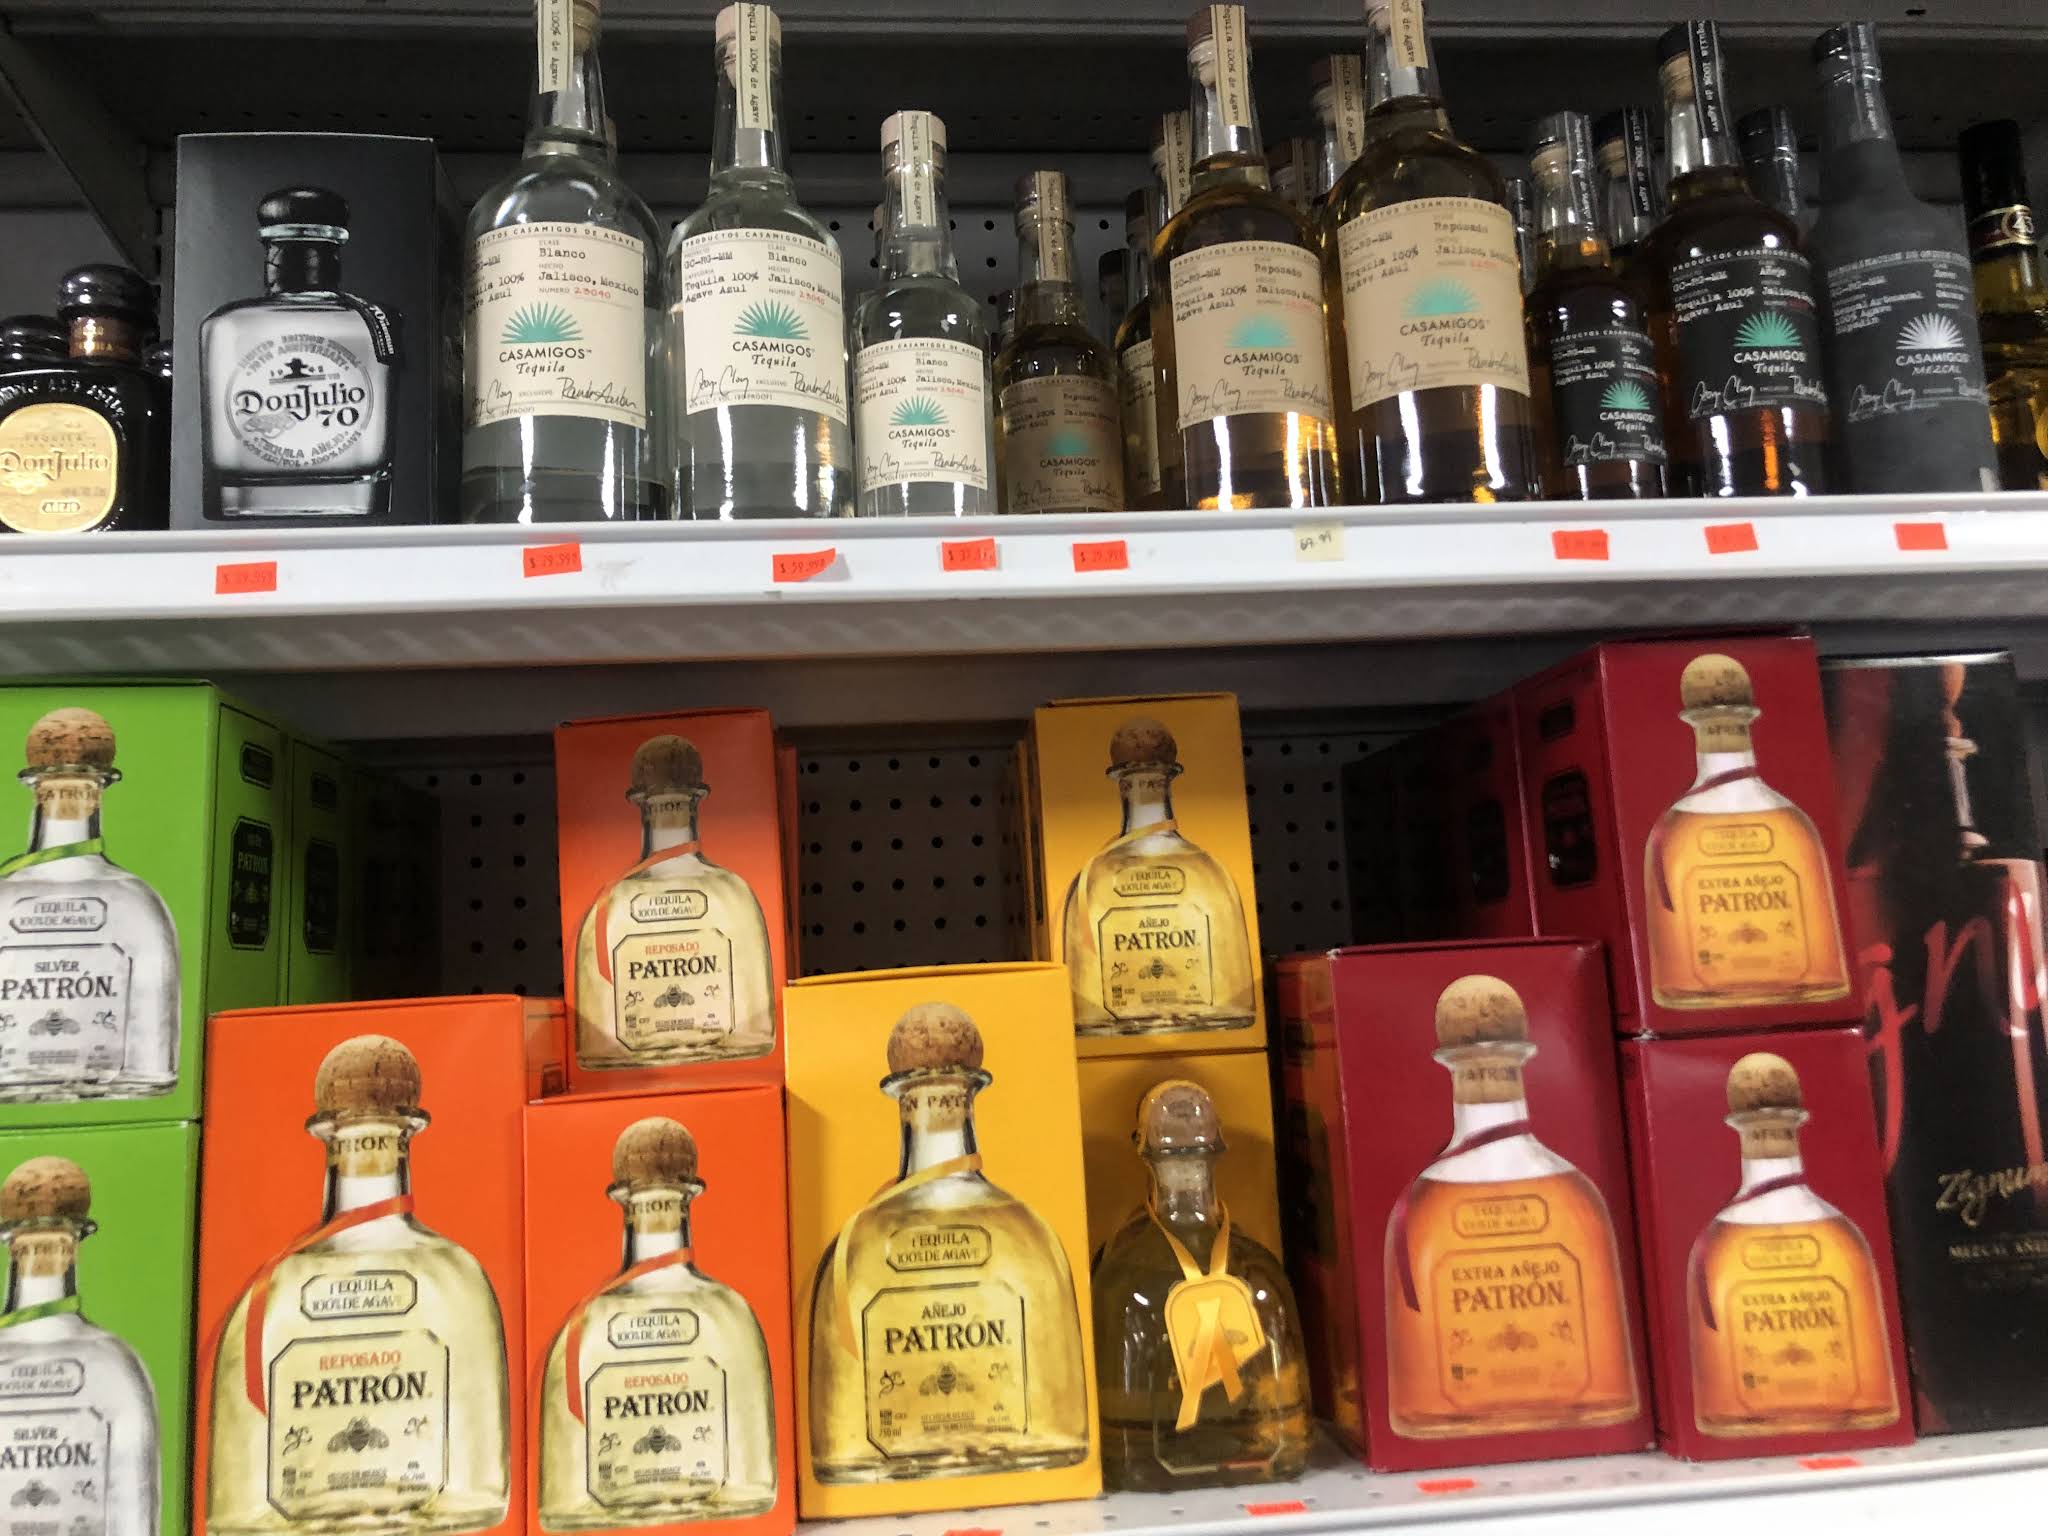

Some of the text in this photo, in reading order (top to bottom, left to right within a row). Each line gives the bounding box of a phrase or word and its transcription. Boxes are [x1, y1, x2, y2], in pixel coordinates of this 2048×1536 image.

[749, 48, 758, 73] 100%
[751, 79, 758, 89] de
[750, 94, 760, 123] Agave
[513, 226, 636, 247] CASAMIGOS DE AGAVE
[745, 231, 803, 244] CASAMIGOS
[539, 247, 586, 259] Blanco
[767, 251, 807, 266] Blanco
[1672, 251, 1732, 273] PRODUCTOS
[538, 271, 597, 286] Jalisco,
[685, 272, 760, 291] Tequila 100%
[685, 289, 713, 303] Agave
[1399, 318, 1486, 337] CASAMIGOS
[1420, 331, 1470, 349] Tequila
[499, 347, 586, 363] CASAMIGOS
[732, 341, 812, 358] CASAMIGOS
[1733, 350, 1807, 364] CASAMIGOS
[751, 354, 797, 369] Tequila
[1223, 351, 1301, 365] CASAMIGOS
[1895, 352, 1970, 367] CASAMIGOS
[516, 361, 565, 377] Tequila
[1242, 365, 1286, 379] Tequila
[1753, 362, 1795, 377] Tequila
[316, 406, 360, 427] 70
[1599, 411, 1656, 423] CASAMIGOS
[888, 428, 951, 440] CASAMIGOS
[1614, 421, 1647, 433] Tequila
[901, 438, 937, 451] Tequila
[1039, 456, 1098, 469] CASAMIGOS
[1052, 469, 1086, 479] Tequila
[1698, 875, 1784, 890] EXTRA AÑEJO
[649, 895, 692, 907] TEQUILA
[1138, 917, 1170, 929] AÑEJO
[644, 941, 700, 956] REPOSADO
[34, 960, 80, 973] SILVER
[628, 952, 717, 981] PATRÓN
[0, 970, 115, 1001] PATRÓN
[911, 1232, 970, 1248] TEQUILA
[1451, 1260, 1561, 1282] EXTRA AÑEJO
[329, 1278, 394, 1296] TEQUILA
[1742, 1293, 1786, 1307] EXTRA
[921, 1302, 967, 1320] AÑEJO
[630, 1314, 681, 1329] TEQUILA
[885, 1313, 1006, 1354] PATRÓN
[319, 1350, 402, 1372] REPOSADO
[623, 1371, 689, 1389] REPOSADO
[292, 1367, 429, 1410] PATRÓN
[604, 1387, 709, 1419] PATRÓN
[13, 1426, 58, 1442] SILVER
[0, 1436, 93, 1470] ATRÓN
